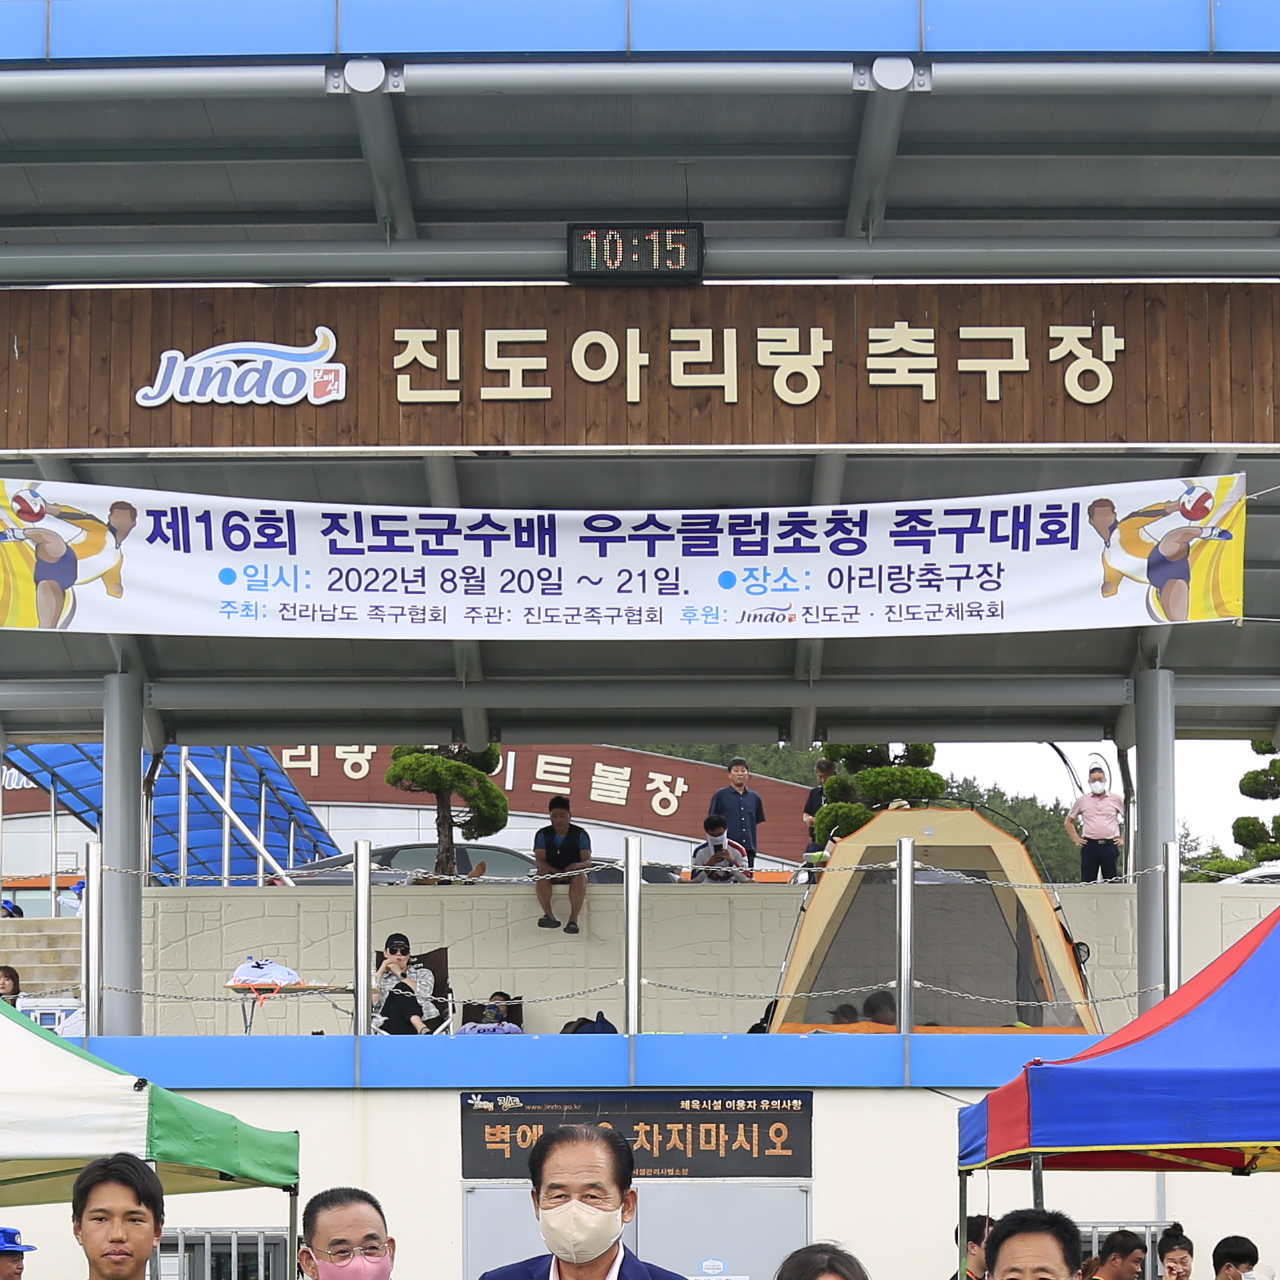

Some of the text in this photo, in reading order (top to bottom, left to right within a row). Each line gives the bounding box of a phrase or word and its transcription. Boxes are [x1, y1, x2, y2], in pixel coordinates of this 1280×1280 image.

[580, 229, 687, 270] 10:15
[140, 354, 307, 401] Jindo
[392, 320, 1126, 406] 진도아리랑 축구장
[145, 501, 1081, 558] 제16회 진도군수배 우수클럽초청 족구대회
[242, 562, 312, 593] 일시:
[326, 566, 427, 595] 2022년
[439, 565, 487, 596] 8월
[499, 566, 564, 596] 20일
[616, 566, 690, 596] 21일.
[741, 564, 812, 596] 장소:
[826, 561, 1006, 594] 아리랑축구장
[218, 599, 1006, 626] 주최: 전라남도 족구협회 주관: 진도군족구협회 후원: Jindo 진도군 진도군체육회
[680, 1099, 722, 1110] 체육시설
[726, 1099, 757, 1110] 이용자
[760, 1099, 802, 1110] 유의사항
[633, 1122, 792, 1158] 차지마시오
